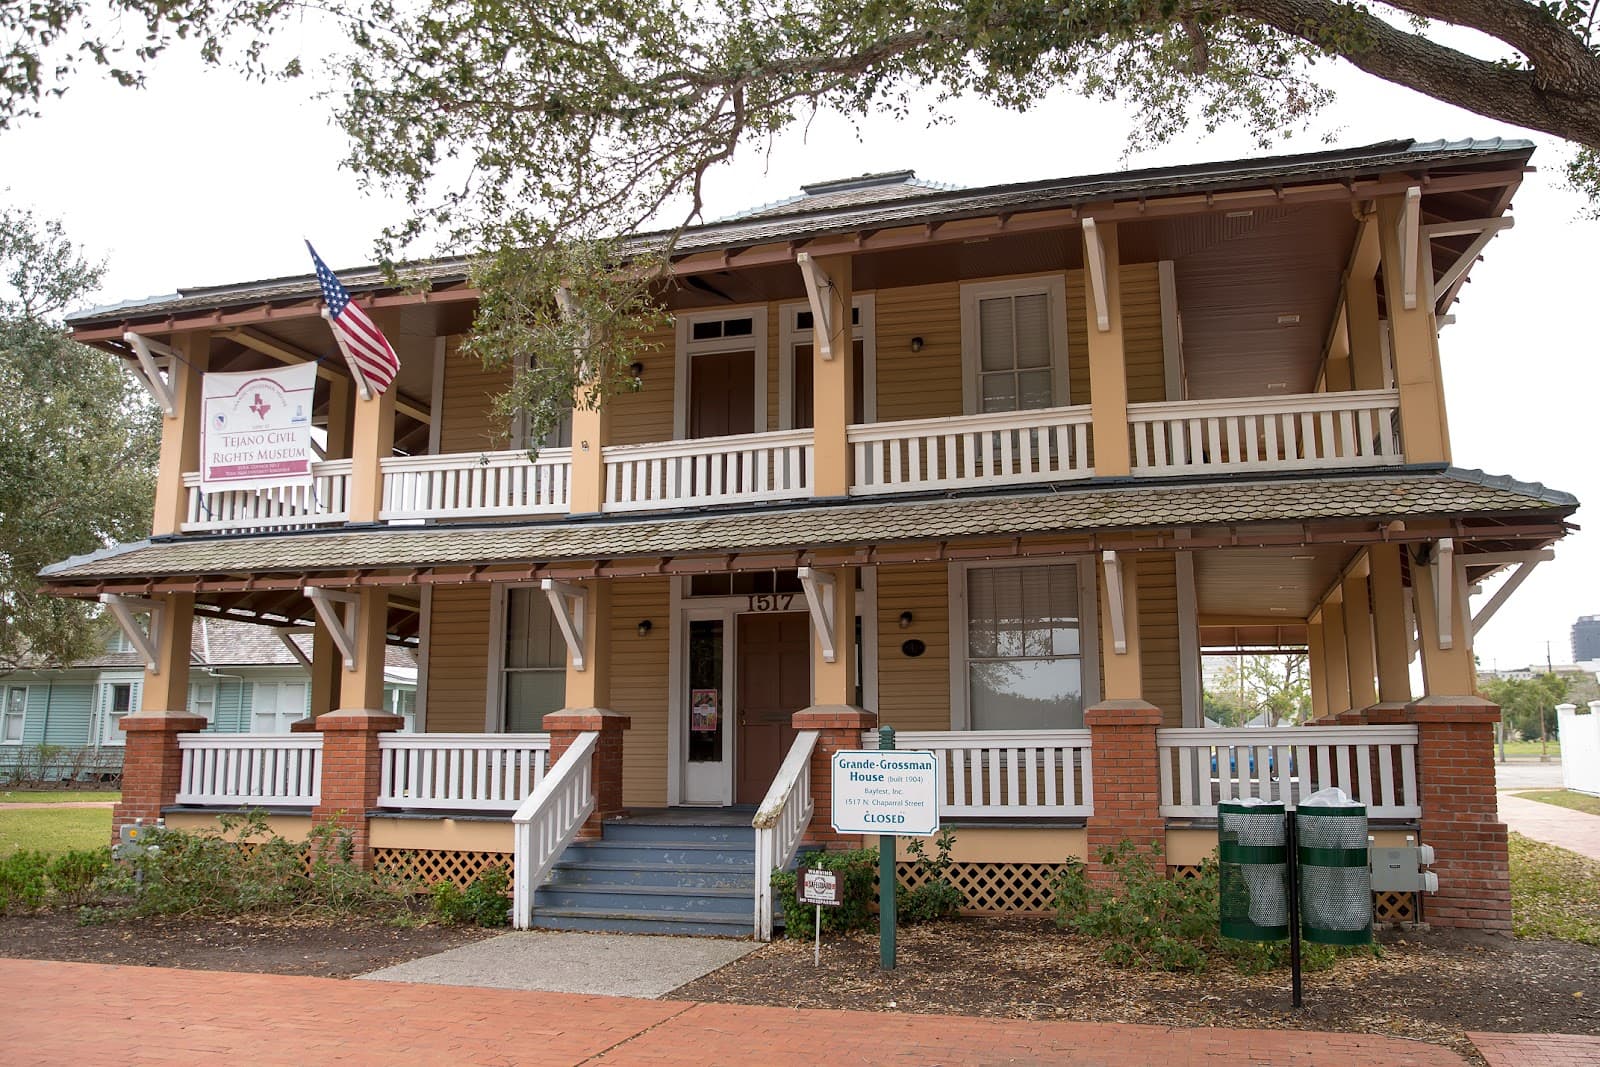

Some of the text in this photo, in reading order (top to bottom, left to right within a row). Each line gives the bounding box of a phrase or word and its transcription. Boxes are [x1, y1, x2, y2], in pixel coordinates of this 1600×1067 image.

[222, 432, 297, 448] TEJANO CIVIL
[213, 447, 305, 464] RIGHTS MUSEUM
[747, 593, 794, 611] 1517
[839, 758, 932, 770] Grande-Grossman
[850, 771, 924, 784] House (built 1904)
[871, 799, 903, 807] Chaparral
[863, 814, 905, 824] CLOSED
